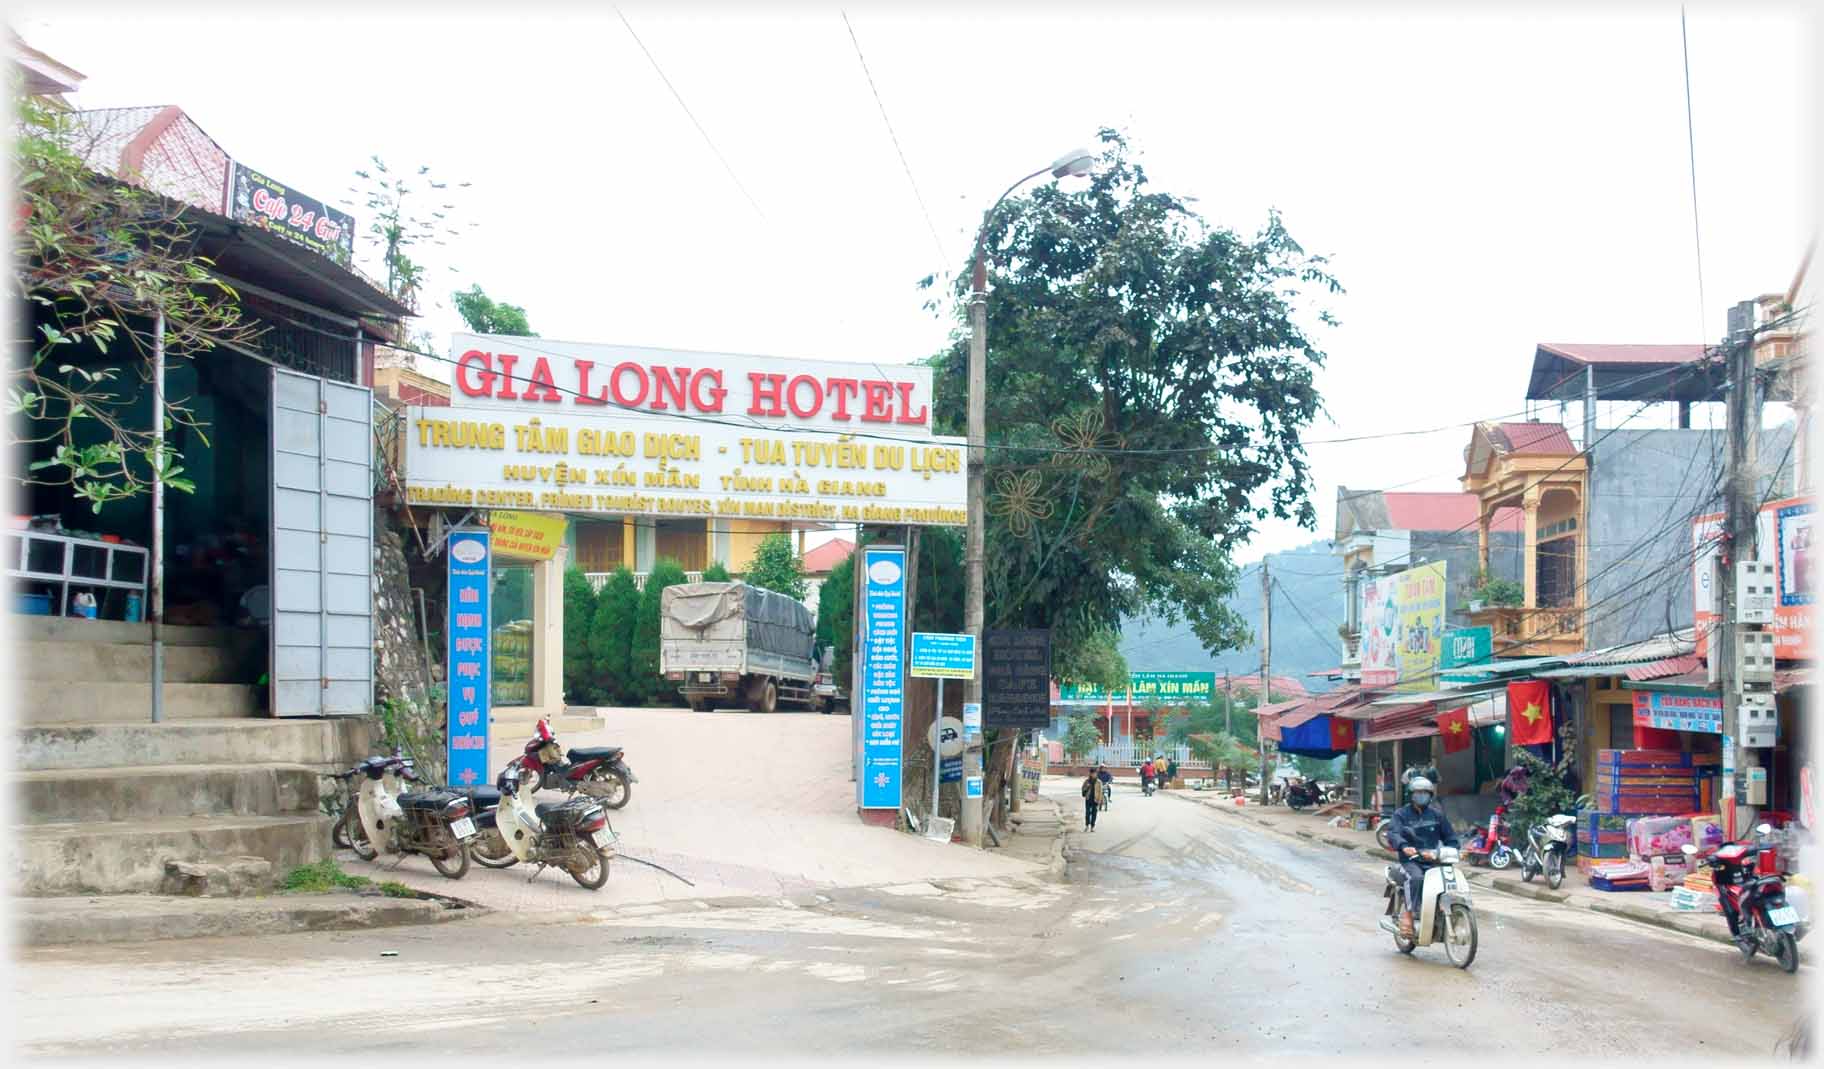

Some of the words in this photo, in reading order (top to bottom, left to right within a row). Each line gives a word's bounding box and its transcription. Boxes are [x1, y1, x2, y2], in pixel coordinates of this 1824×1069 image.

[288, 204, 315, 231] 24
[455, 350, 562, 402] GIA
[574, 359, 727, 413] LONG
[747, 372, 928, 425] HOTEL
[416, 418, 505, 450] TRUNG
[514, 416, 569, 455] TÂM
[577, 428, 636, 457] GIAO
[643, 432, 701, 465] DỊCH
[740, 437, 787, 465] TUA
[792, 432, 867, 469] TUYẾN
[873, 444, 905, 470] DU
[911, 446, 961, 480] LỊCH
[503, 461, 587, 486] HUYỆN
[594, 462, 638, 487] XÍN
[778, 470, 810, 494] HÀ
[817, 479, 887, 497] GIANG
[1159, 680, 1180, 694] XÍN
